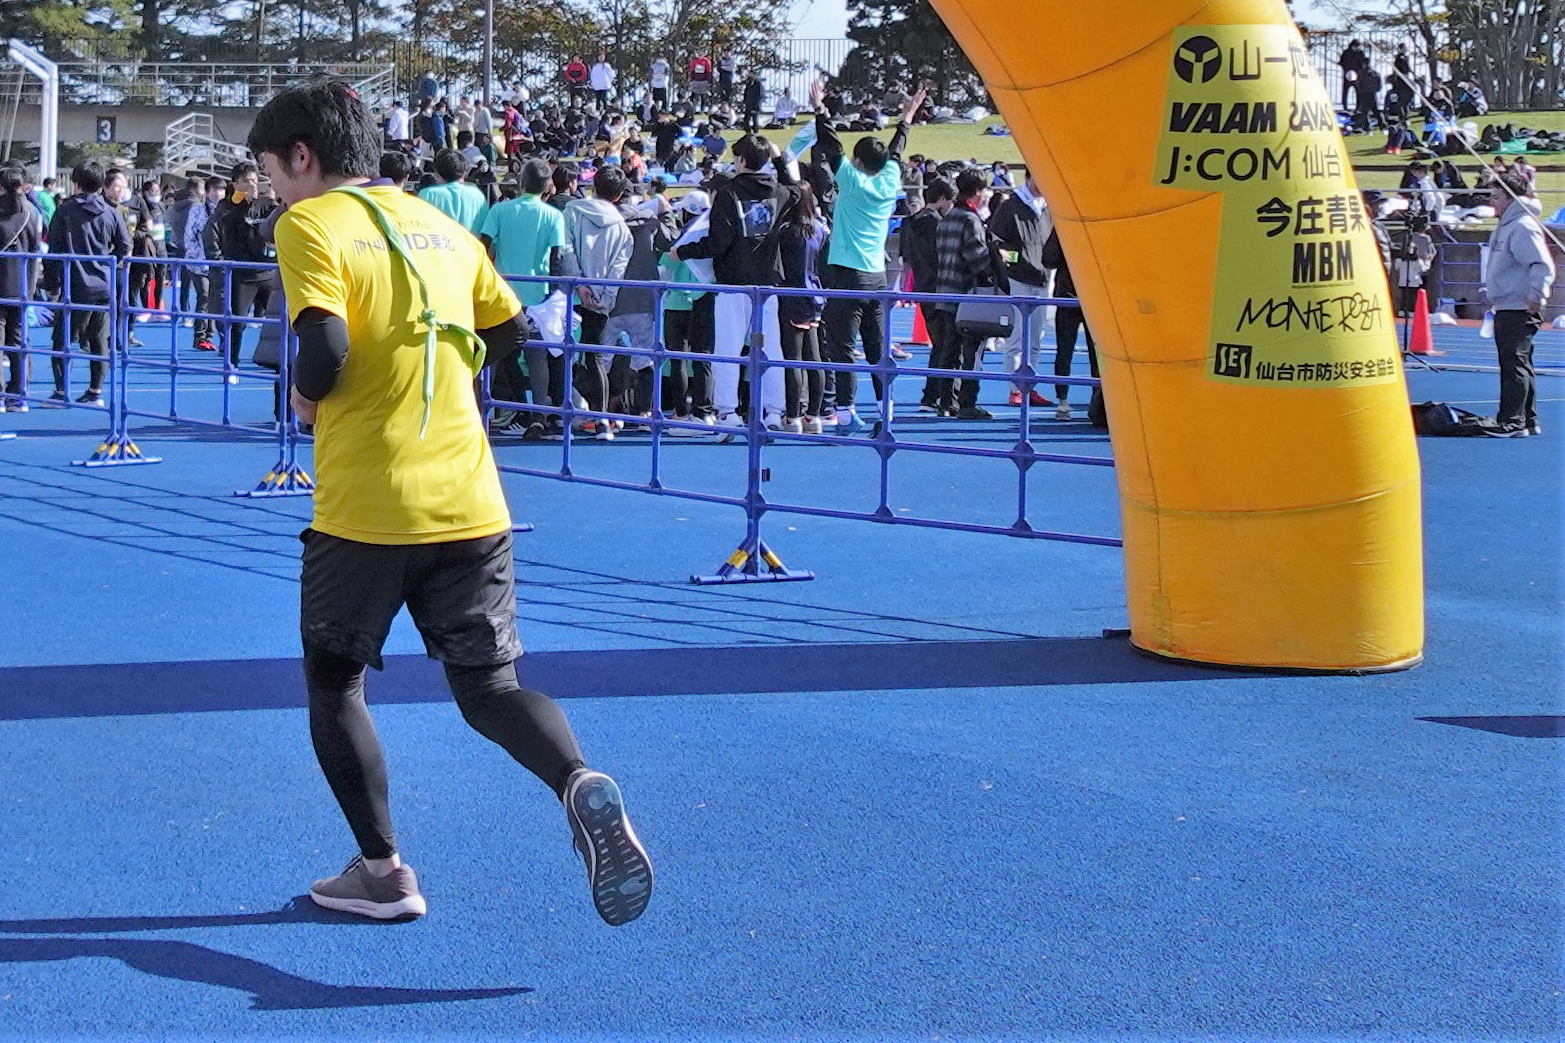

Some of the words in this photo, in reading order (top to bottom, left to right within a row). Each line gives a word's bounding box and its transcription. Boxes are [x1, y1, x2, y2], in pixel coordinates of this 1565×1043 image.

[100, 119, 112, 142] 3
[1169, 101, 1278, 134] VAAM
[1161, 146, 1291, 185] J:COM
[1302, 144, 1342, 179] 仙台
[1256, 195, 1366, 237] 今庄青果
[1292, 239, 1354, 284] MBM
[1255, 356, 1396, 382] 仙台市防災安全協会
